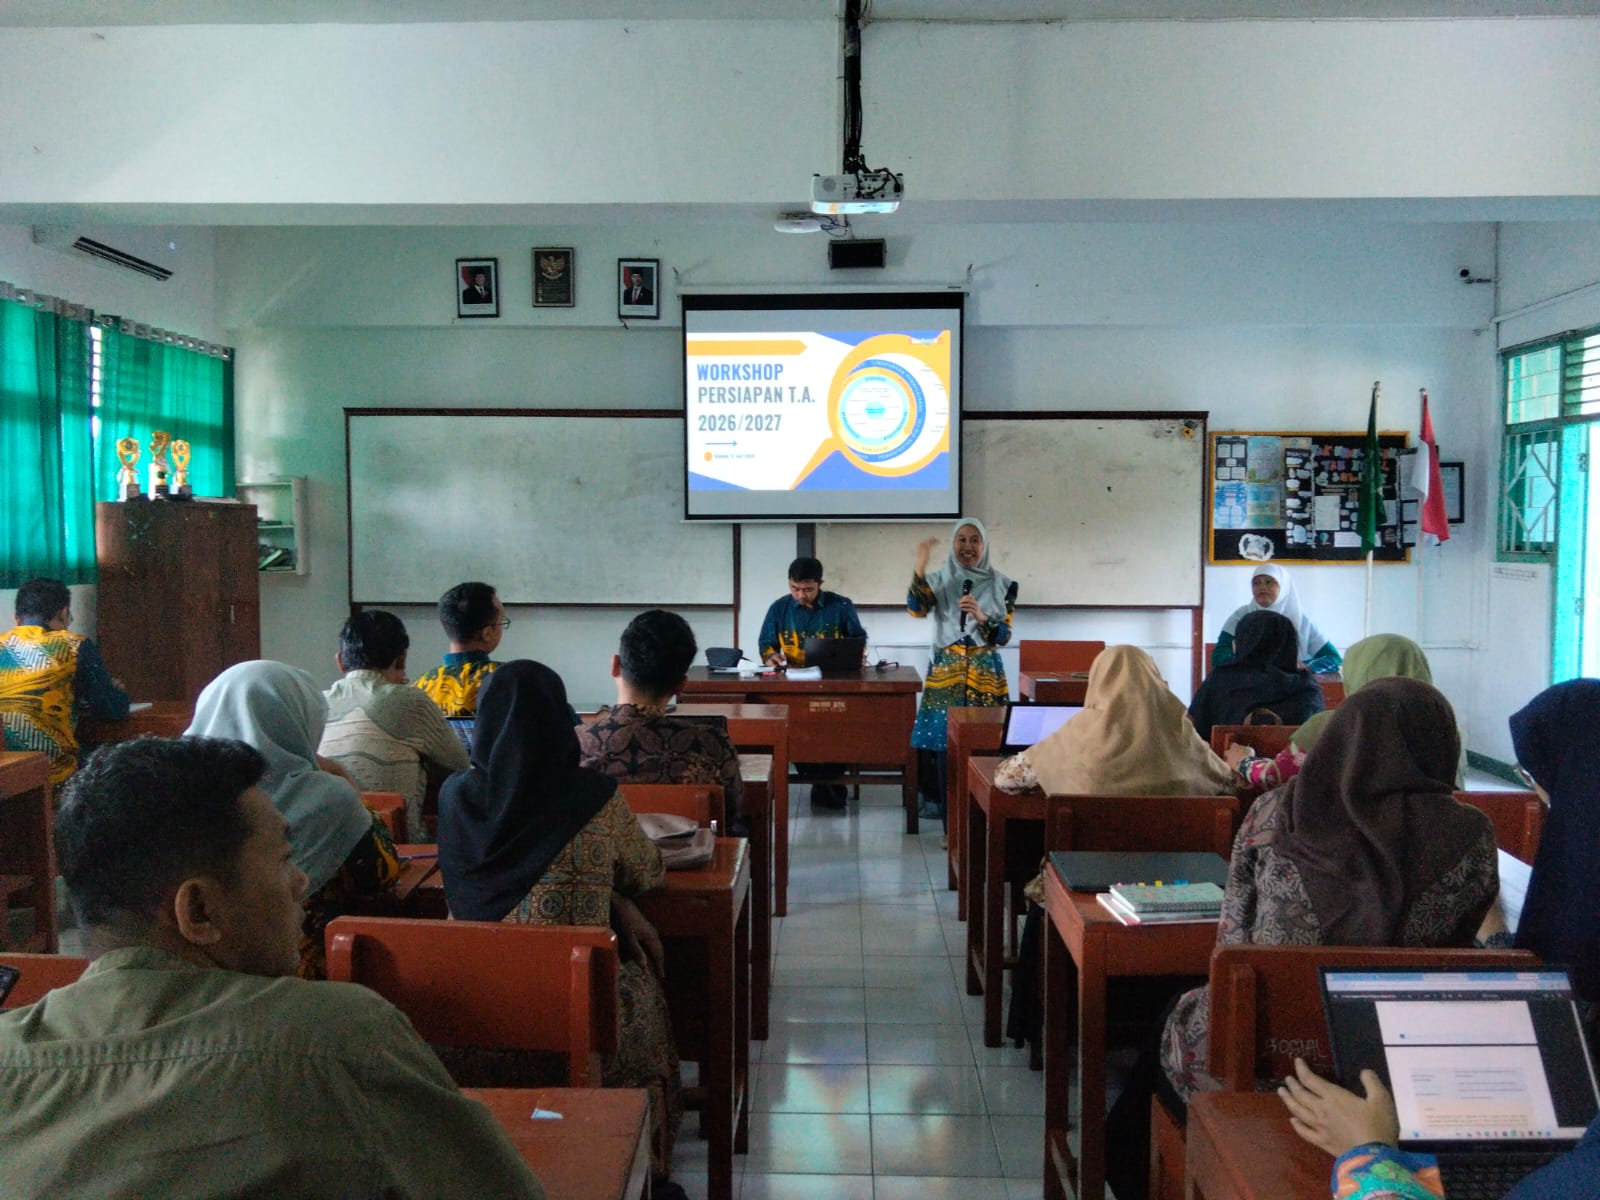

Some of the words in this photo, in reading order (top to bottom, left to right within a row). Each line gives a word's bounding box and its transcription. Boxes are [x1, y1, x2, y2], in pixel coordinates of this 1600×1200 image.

[697, 363, 783, 381] WORKSHOP
[698, 386, 783, 404] PERSIAPAN
[788, 386, 815, 403] T.A.
[698, 414, 782, 432] 2026/2027
